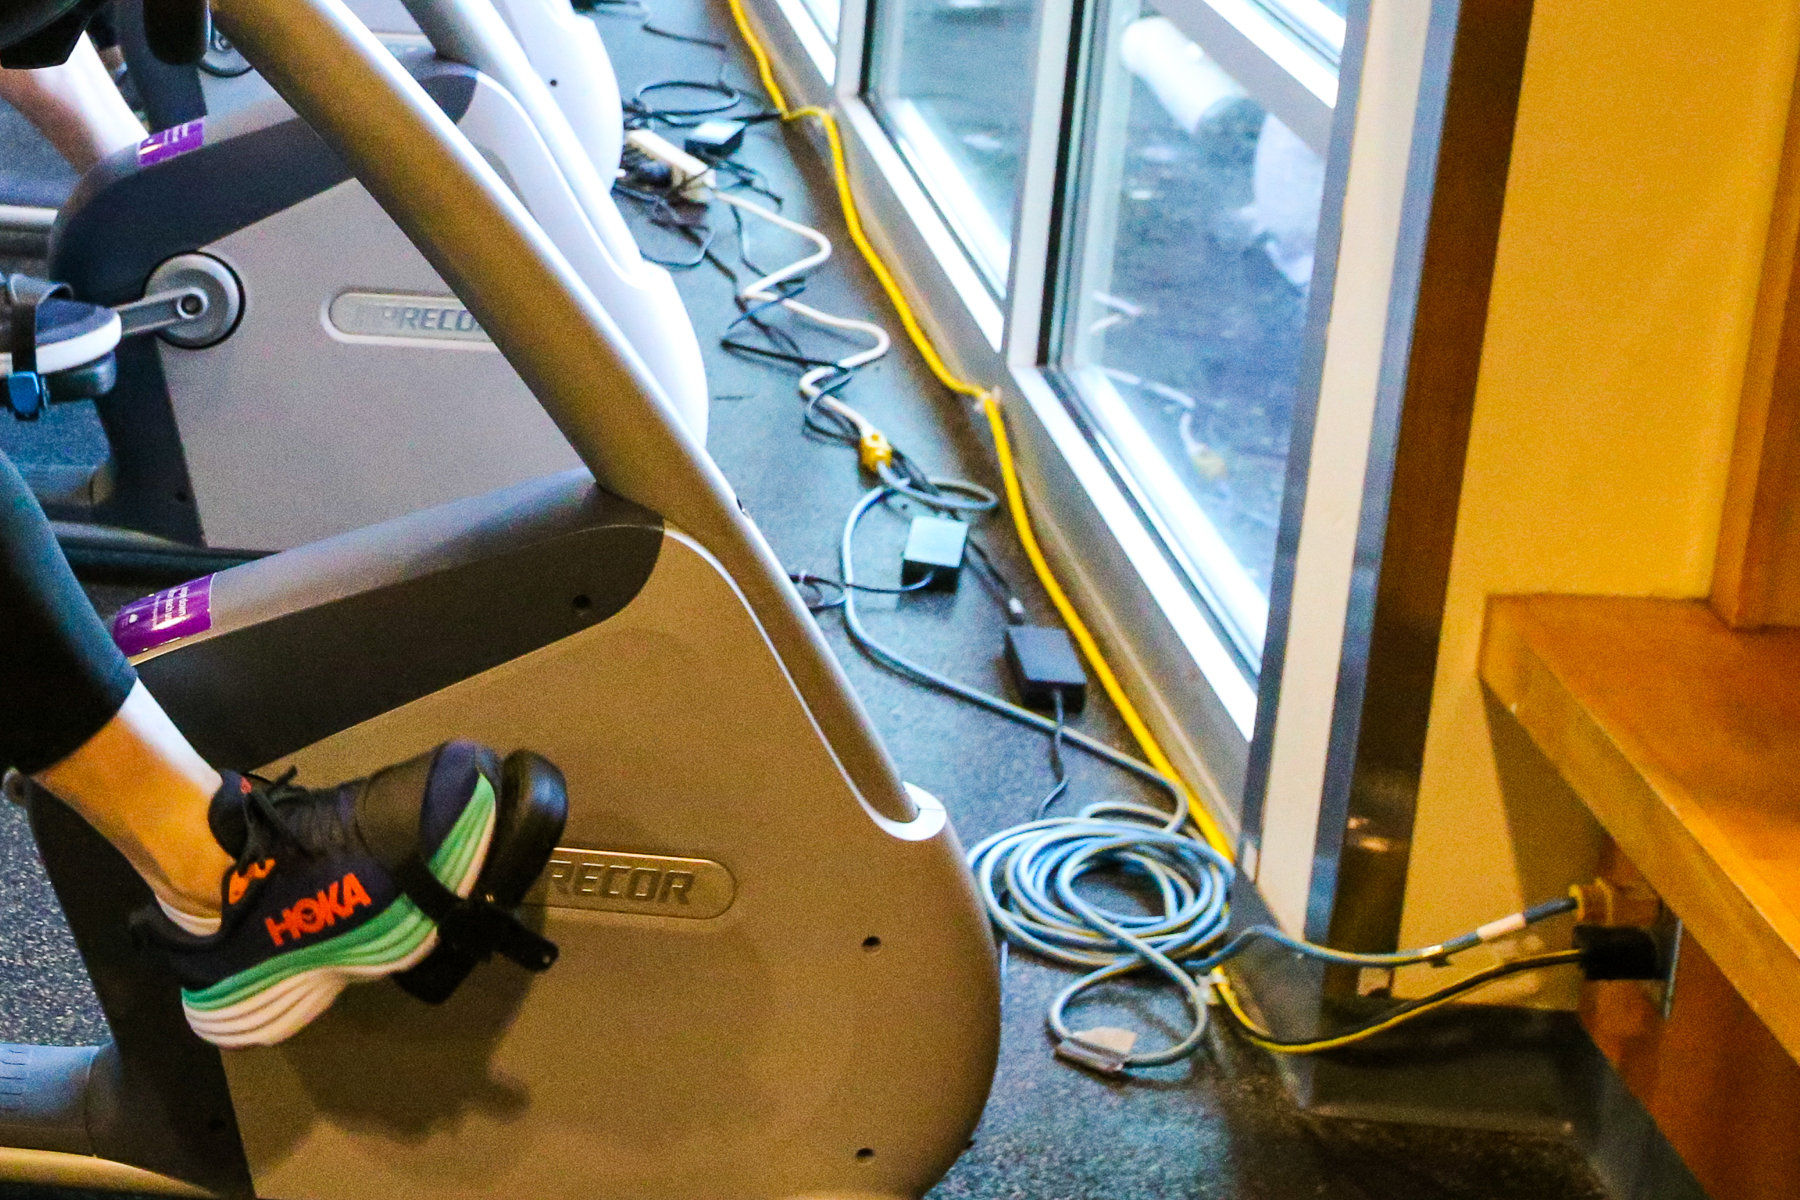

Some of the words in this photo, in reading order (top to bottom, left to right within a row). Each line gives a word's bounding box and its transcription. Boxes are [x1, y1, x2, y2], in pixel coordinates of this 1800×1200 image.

[379, 306, 484, 332] PRECO
[545, 859, 695, 906] RECOR
[264, 872, 372, 947] HOKA
